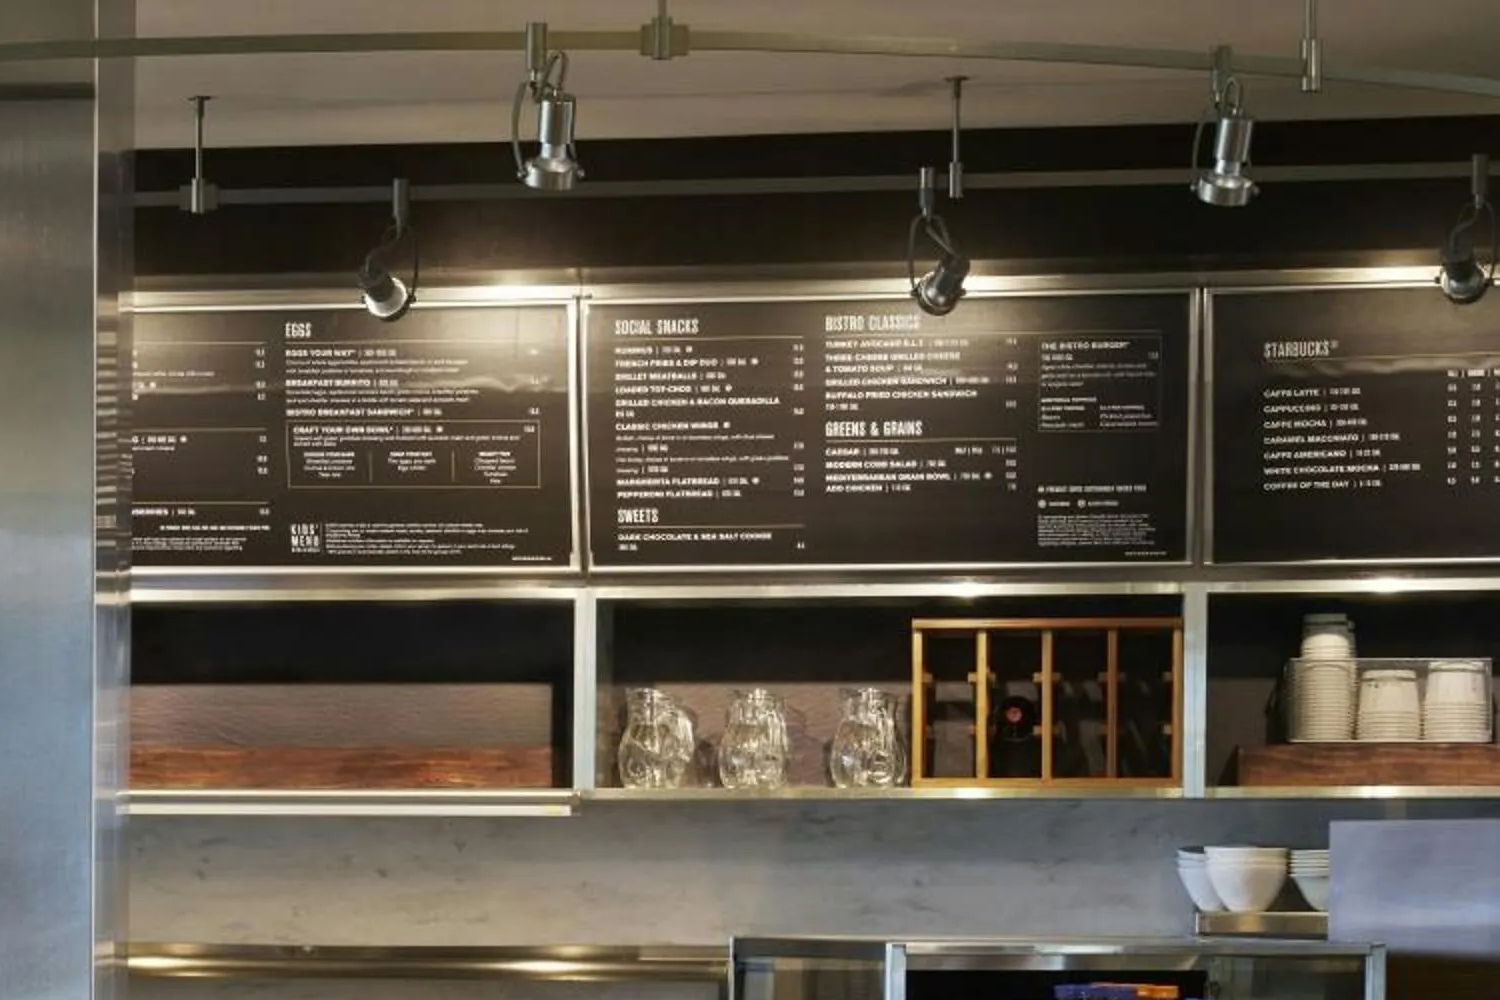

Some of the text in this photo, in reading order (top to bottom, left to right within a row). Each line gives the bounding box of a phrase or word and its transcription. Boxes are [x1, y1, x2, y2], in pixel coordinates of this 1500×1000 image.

[285, 322, 311, 338] EGGS
[615, 318, 699, 335] SOCIAL SNACKS
[825, 315, 864, 331] BISTRO
[825, 420, 923, 437] GREENS & GRAINS
[617, 508, 659, 523] SWEETS
[291, 535, 320, 547] MENU
